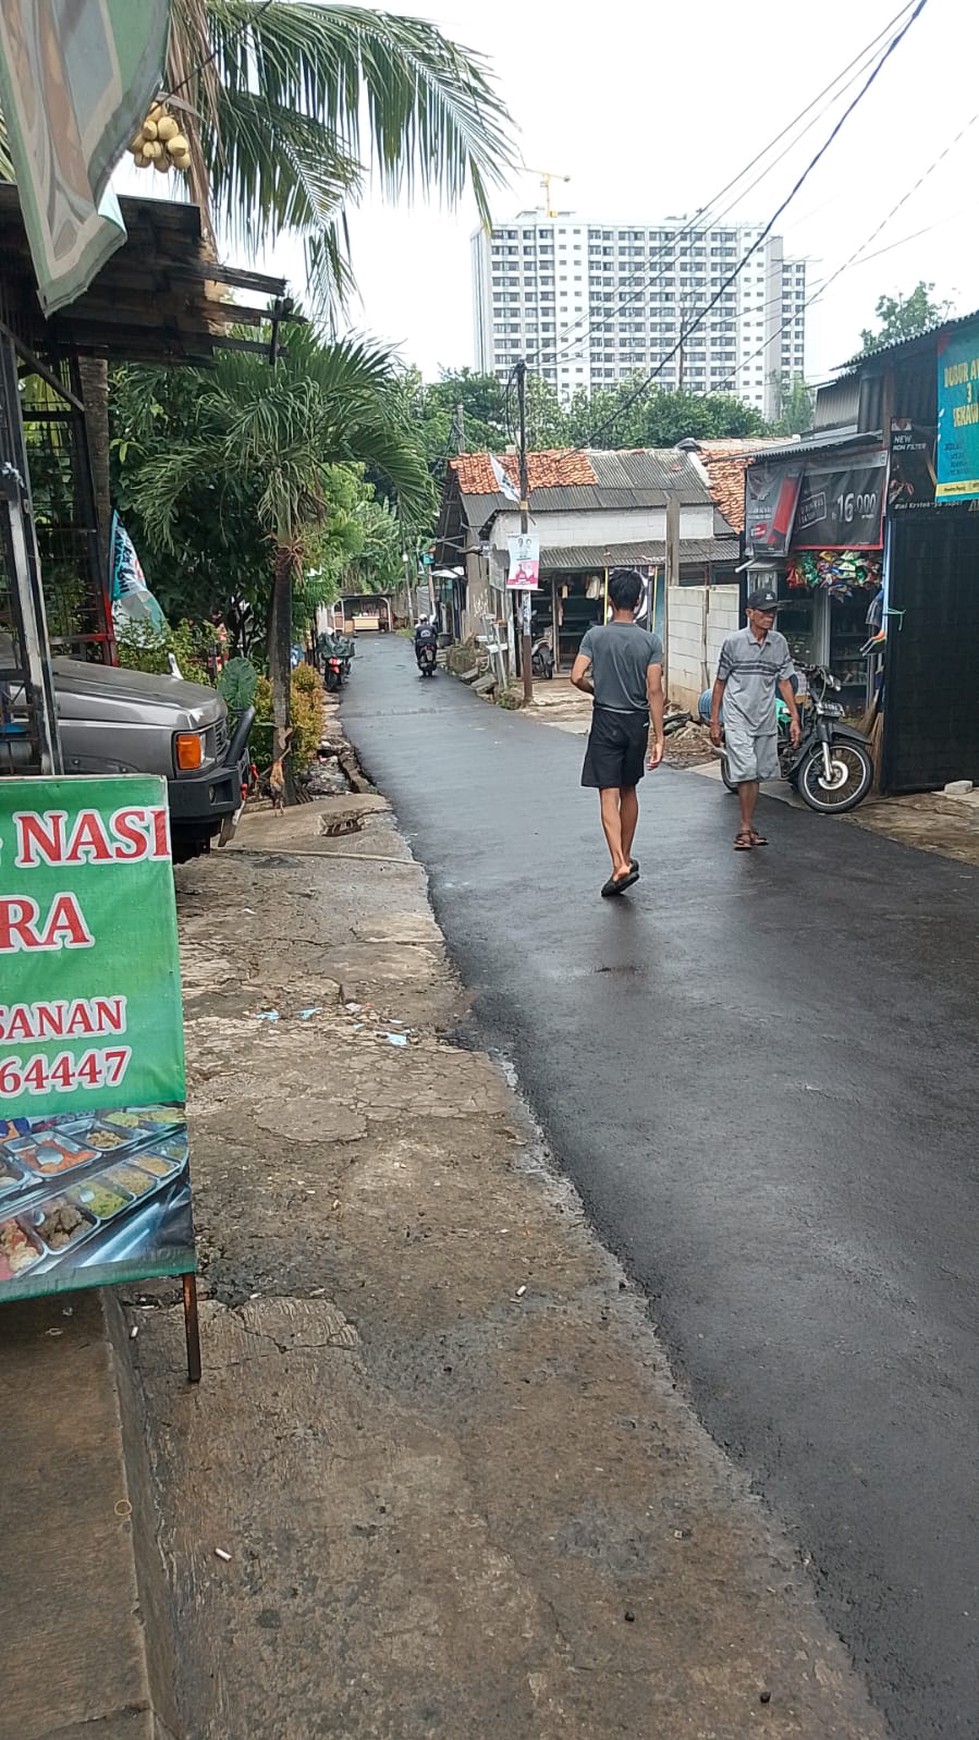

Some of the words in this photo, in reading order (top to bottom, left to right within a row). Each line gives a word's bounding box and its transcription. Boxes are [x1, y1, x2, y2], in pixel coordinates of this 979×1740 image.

[894, 435, 912, 444] NEW
[906, 443, 927, 451] FILTER
[17, 810, 171, 863] NASI
[0, 1000, 123, 1040] ANAN
[0, 1050, 128, 1094] 64447
